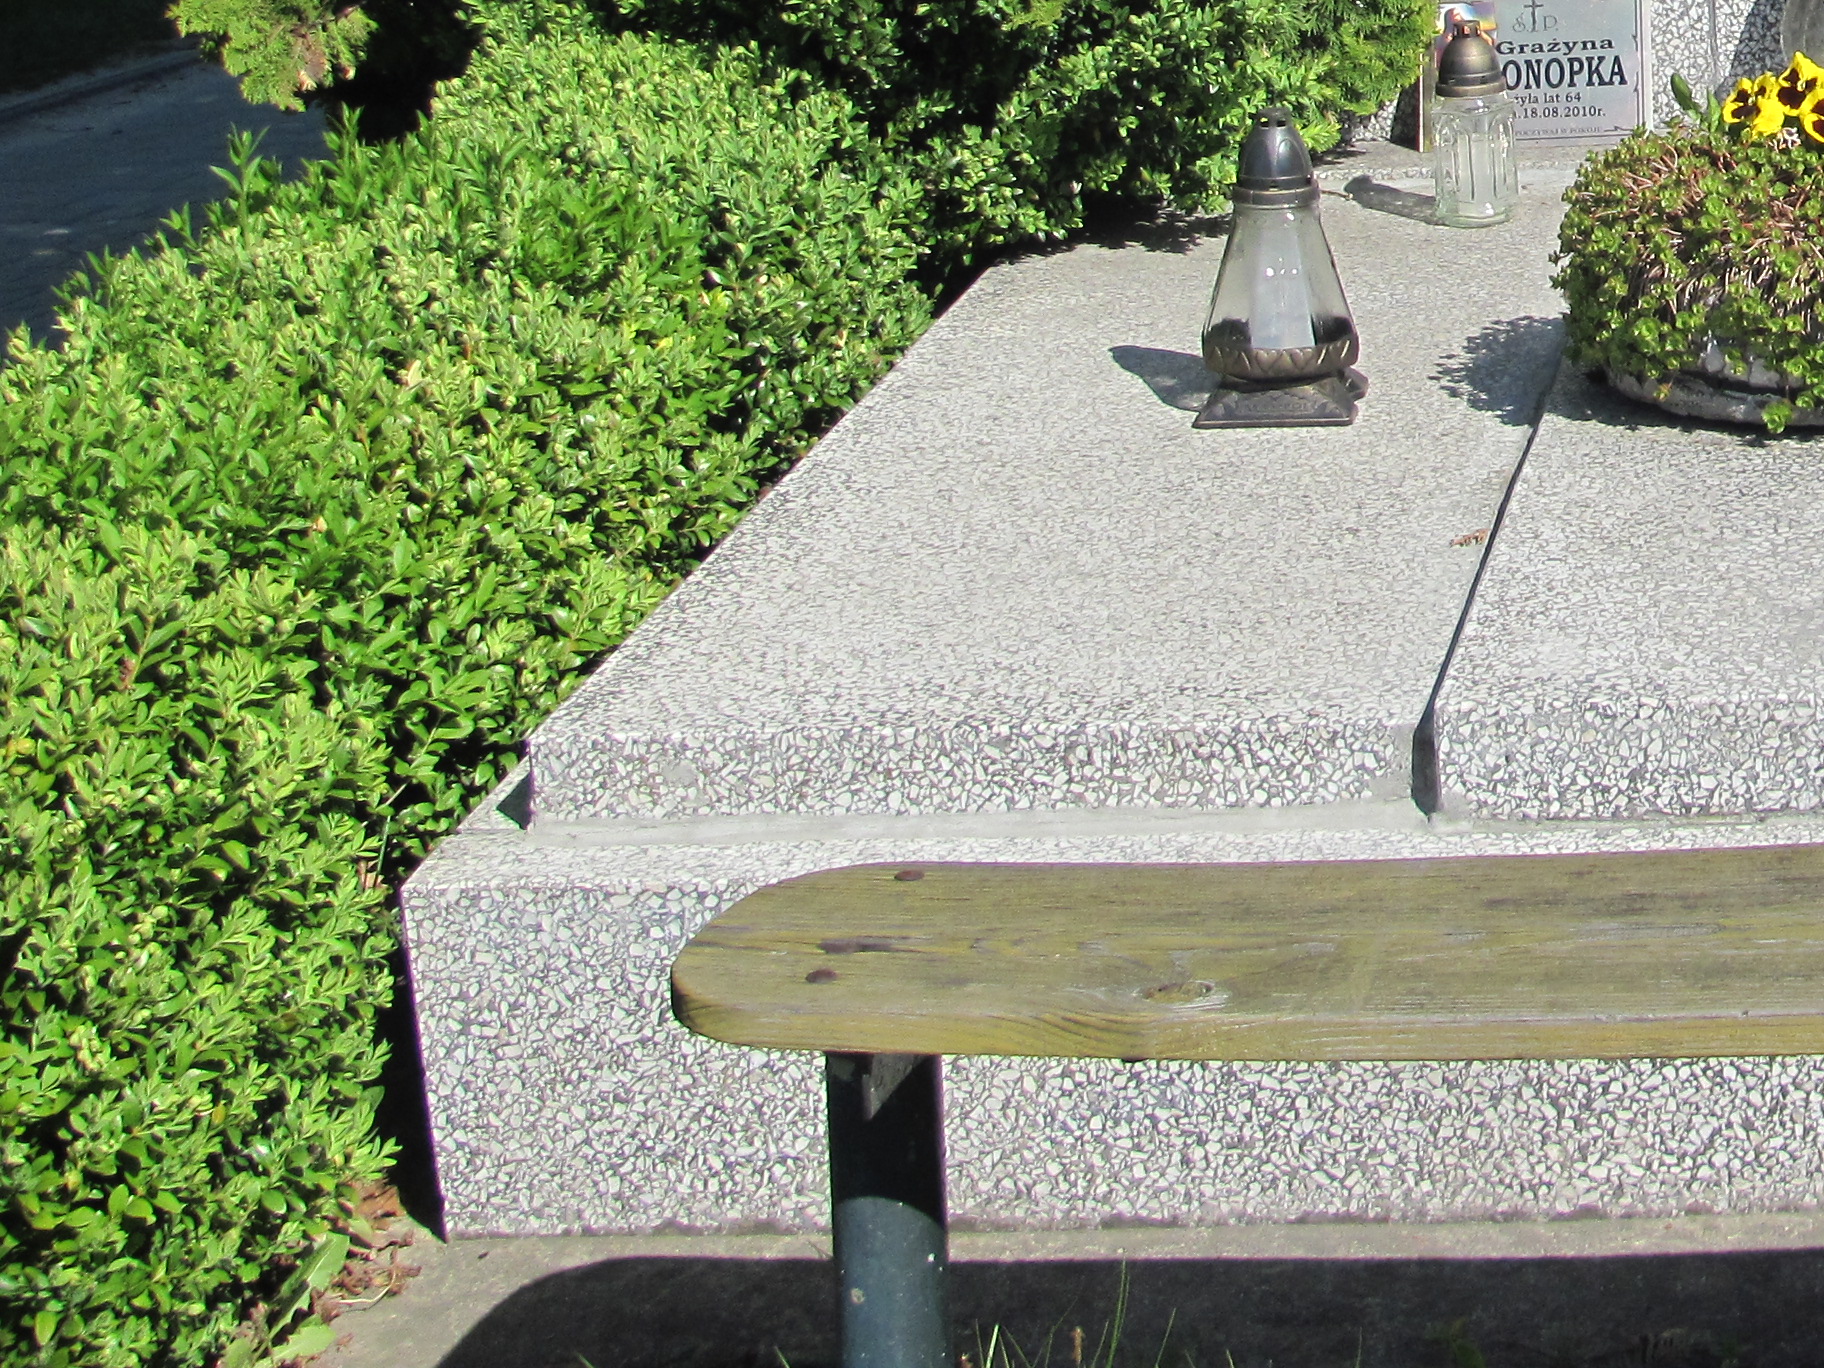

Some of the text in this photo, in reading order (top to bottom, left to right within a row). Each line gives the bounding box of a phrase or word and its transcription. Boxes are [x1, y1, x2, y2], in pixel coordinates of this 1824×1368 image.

[1496, 37, 1615, 56] Grażyna
[1502, 54, 1628, 91] ONOPKA
[1544, 93, 1560, 104] lat
[1565, 92, 1581, 103] 64
